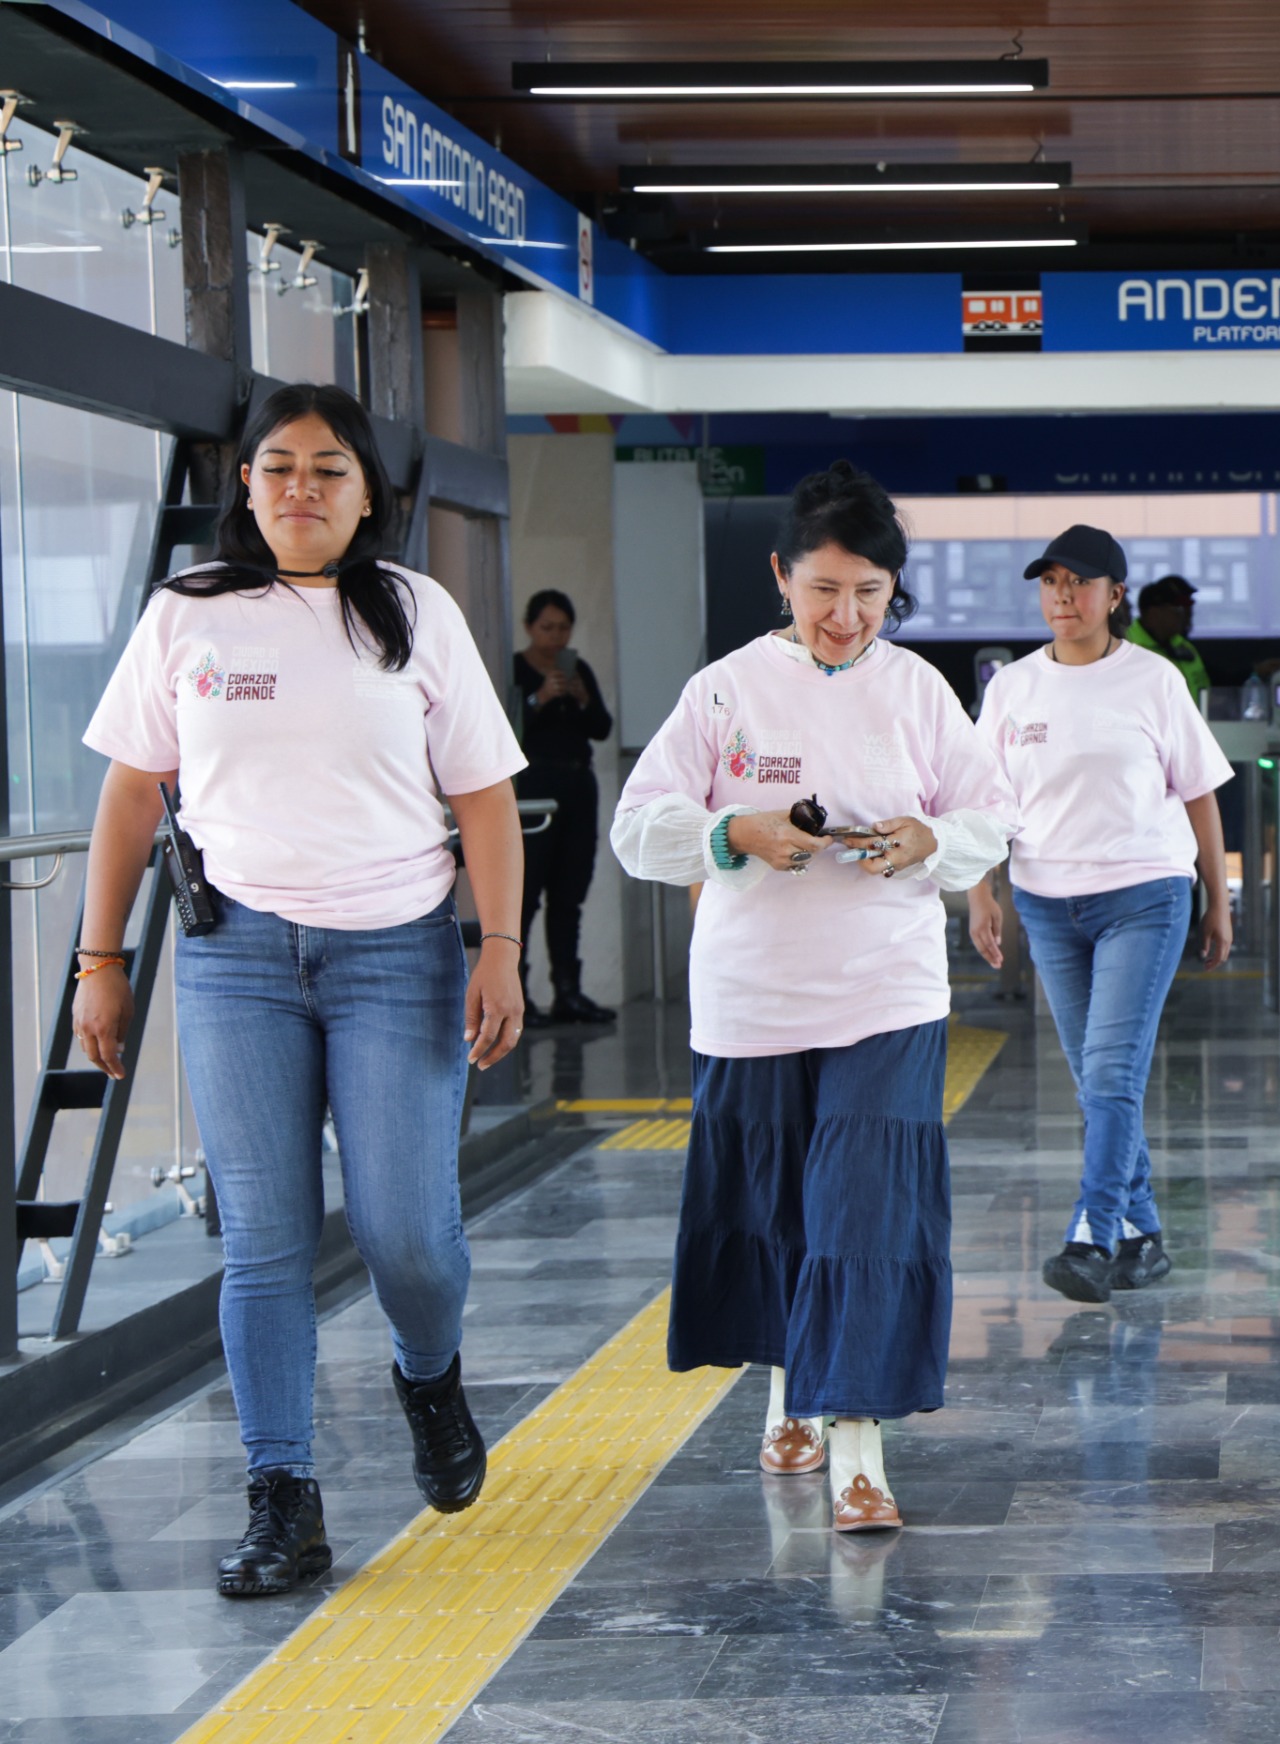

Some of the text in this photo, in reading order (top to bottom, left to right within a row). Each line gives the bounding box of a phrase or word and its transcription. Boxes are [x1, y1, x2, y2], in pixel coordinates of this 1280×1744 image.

[382, 95, 526, 247] SAN ANTONIO ABAD
[226, 685, 276, 701] GRANDE
[713, 692, 725, 706] L
[758, 769, 801, 785] GRANDE
